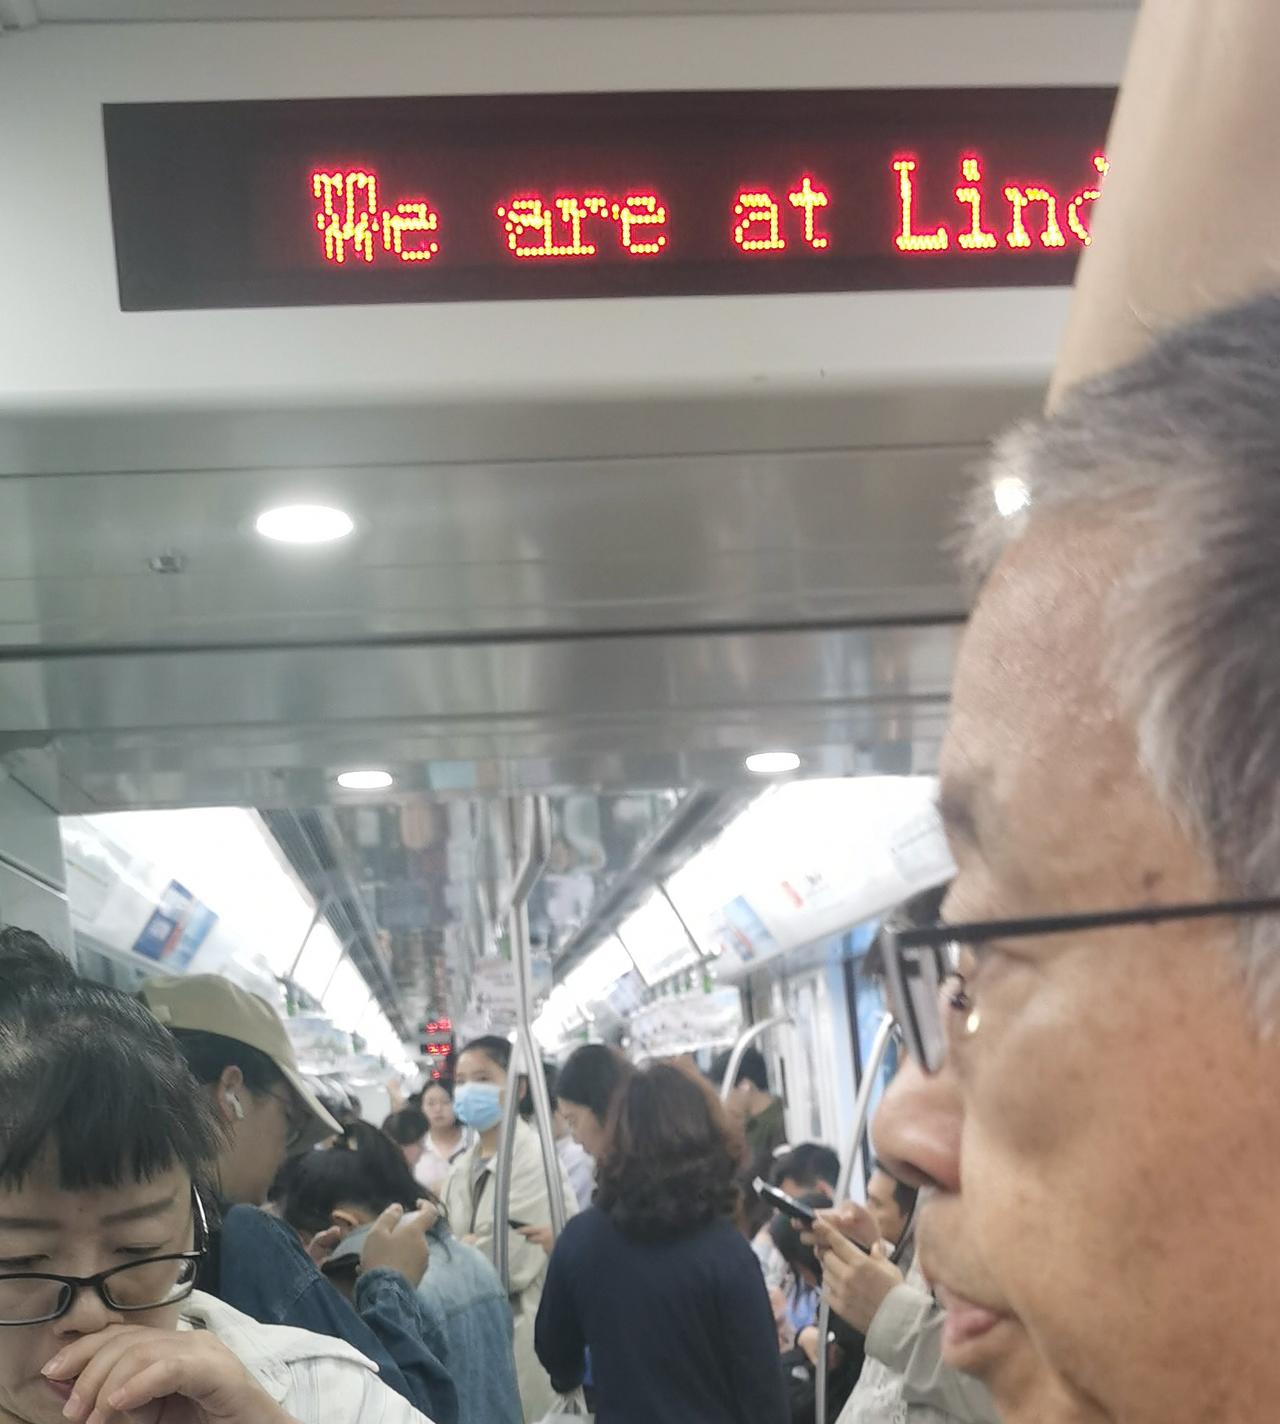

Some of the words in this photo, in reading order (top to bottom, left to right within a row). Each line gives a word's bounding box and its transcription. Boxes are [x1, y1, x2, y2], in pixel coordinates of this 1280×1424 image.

[311, 170, 439, 264] We
[497, 195, 667, 259] are
[733, 176, 828, 251] at
